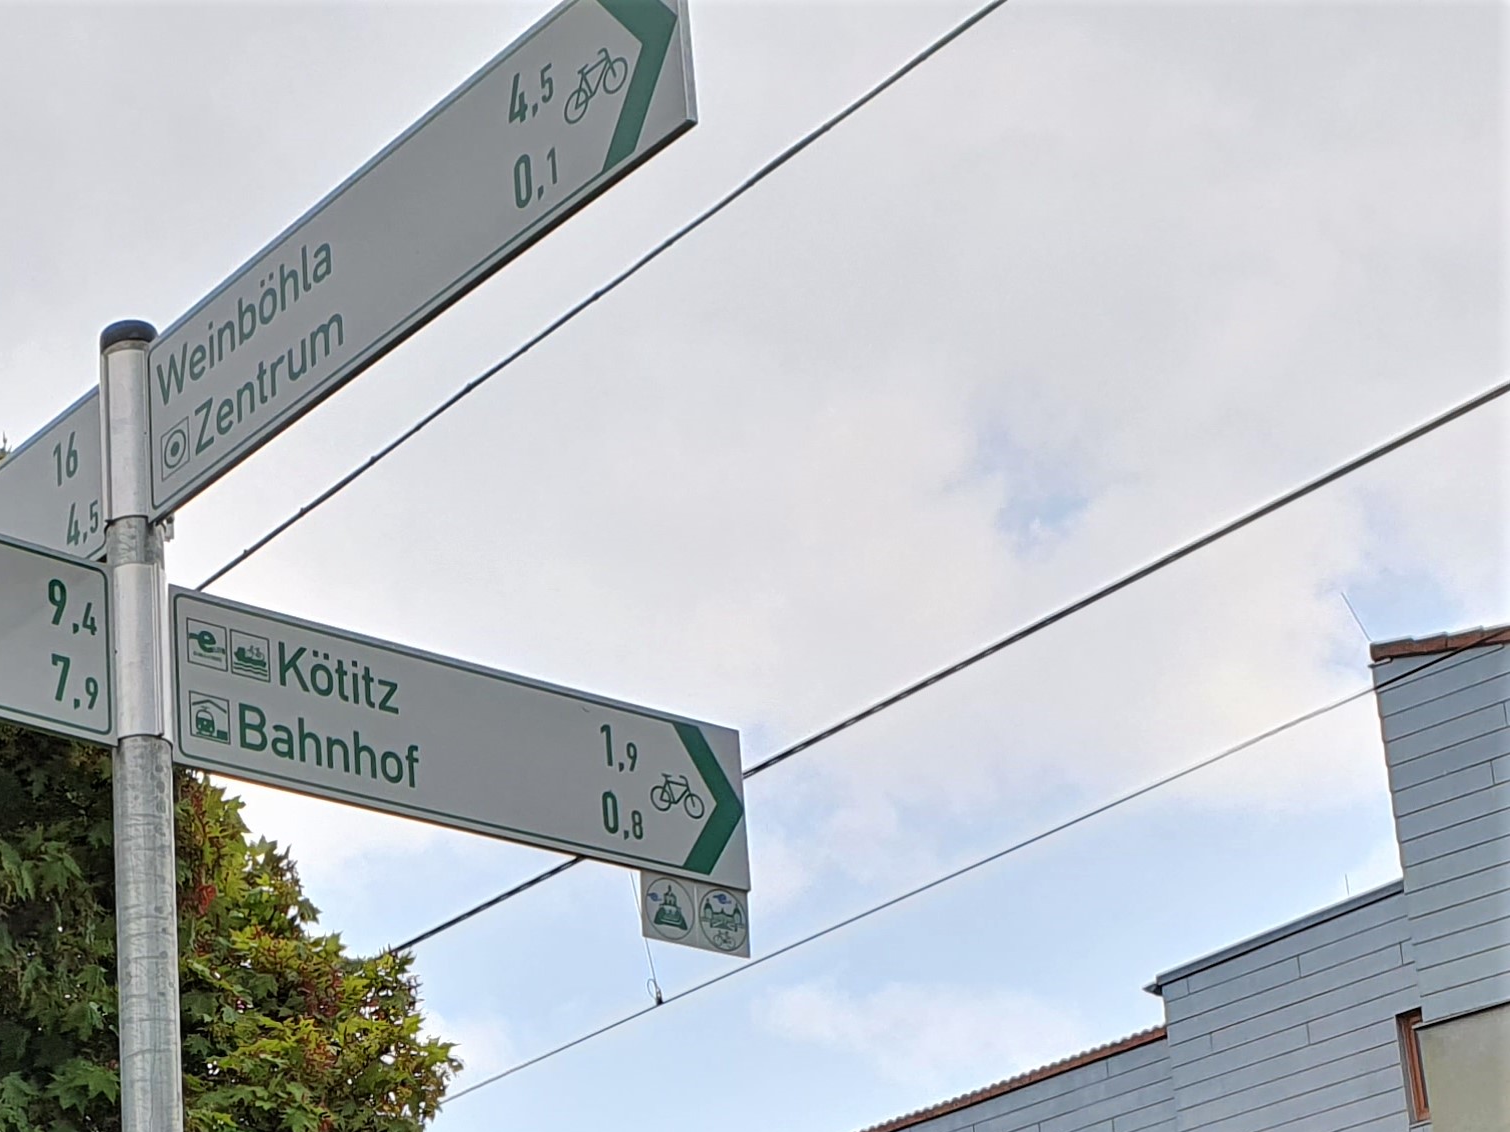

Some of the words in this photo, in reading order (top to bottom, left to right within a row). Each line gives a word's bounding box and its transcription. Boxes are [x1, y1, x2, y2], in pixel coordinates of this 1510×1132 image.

[157, 243, 331, 405] Weinböhla
[509, 63, 553, 123] 4,5
[195, 314, 343, 456] Zentrum
[514, 147, 557, 208] 0,1
[53, 431, 78, 486] 16
[67, 500, 98, 546] 4,5
[48, 579, 97, 635] 9,4
[52, 654, 98, 709] 7,9
[278, 641, 399, 714] Kötitz
[601, 724, 637, 772] 1,9
[239, 703, 419, 788] Bahnhof
[602, 791, 643, 840] 0,8
